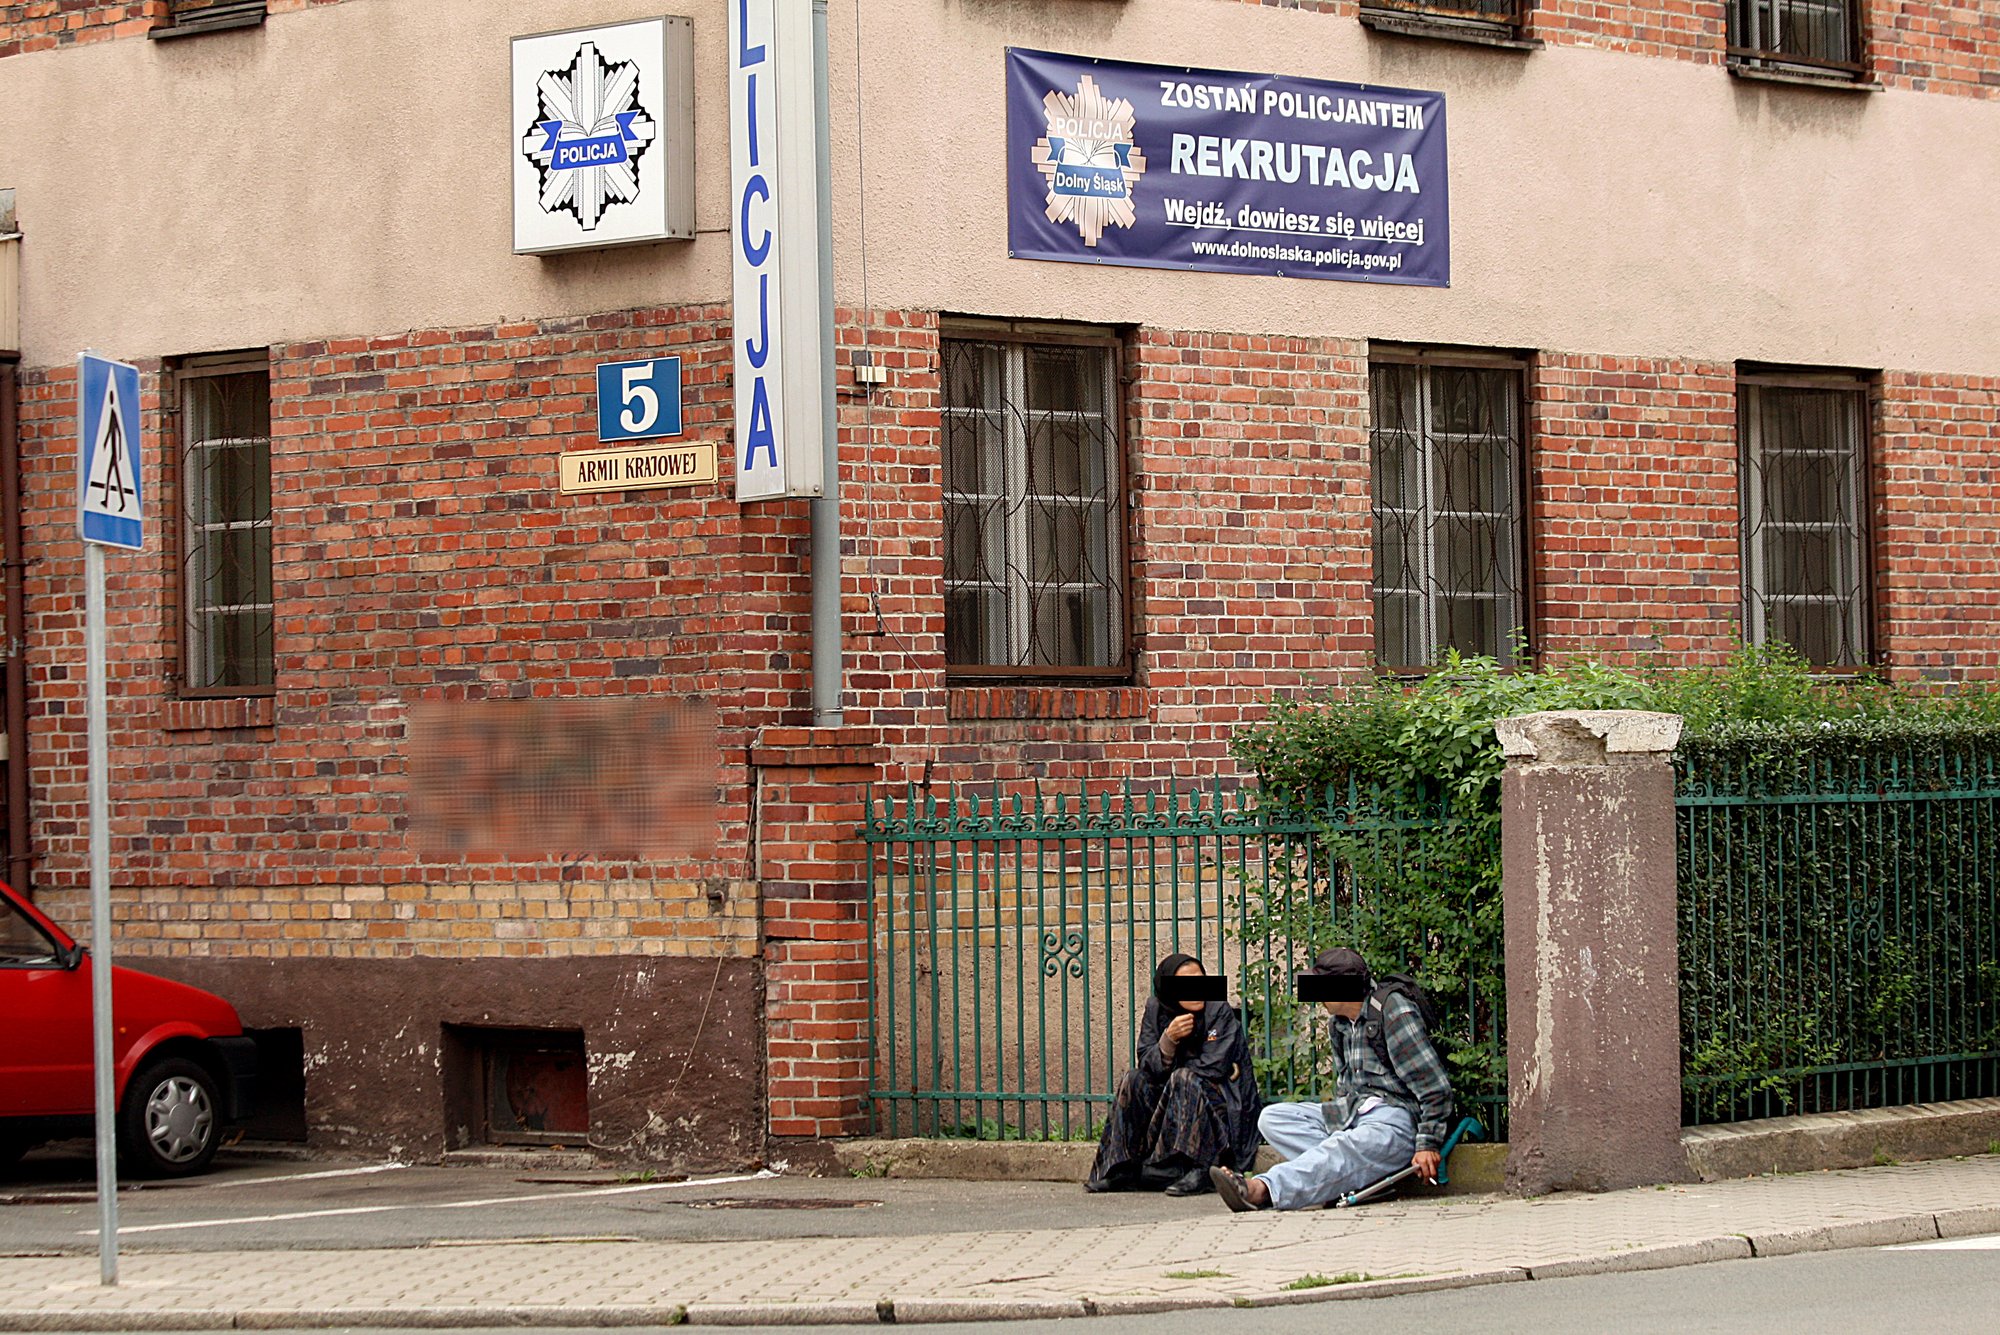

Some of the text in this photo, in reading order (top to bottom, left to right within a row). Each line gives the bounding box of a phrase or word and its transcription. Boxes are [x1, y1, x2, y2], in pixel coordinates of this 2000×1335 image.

[1160, 82, 1424, 130] ZOSTAŃ POLICJANTEM
[1056, 117, 1123, 141] POLICJA
[559, 144, 618, 164] POLICJA
[1170, 133, 1420, 194] REKRUTACJA
[1056, 172, 1124, 194] Dolny Śląsk
[1164, 198, 1424, 245] Wejdź, dowiesz się więcej
[1192, 241, 1402, 270] www.dolnoslaska.policja.gov.pl
[619, 361, 659, 433] 5
[578, 453, 697, 483] ARMII KRAJOWEJ
